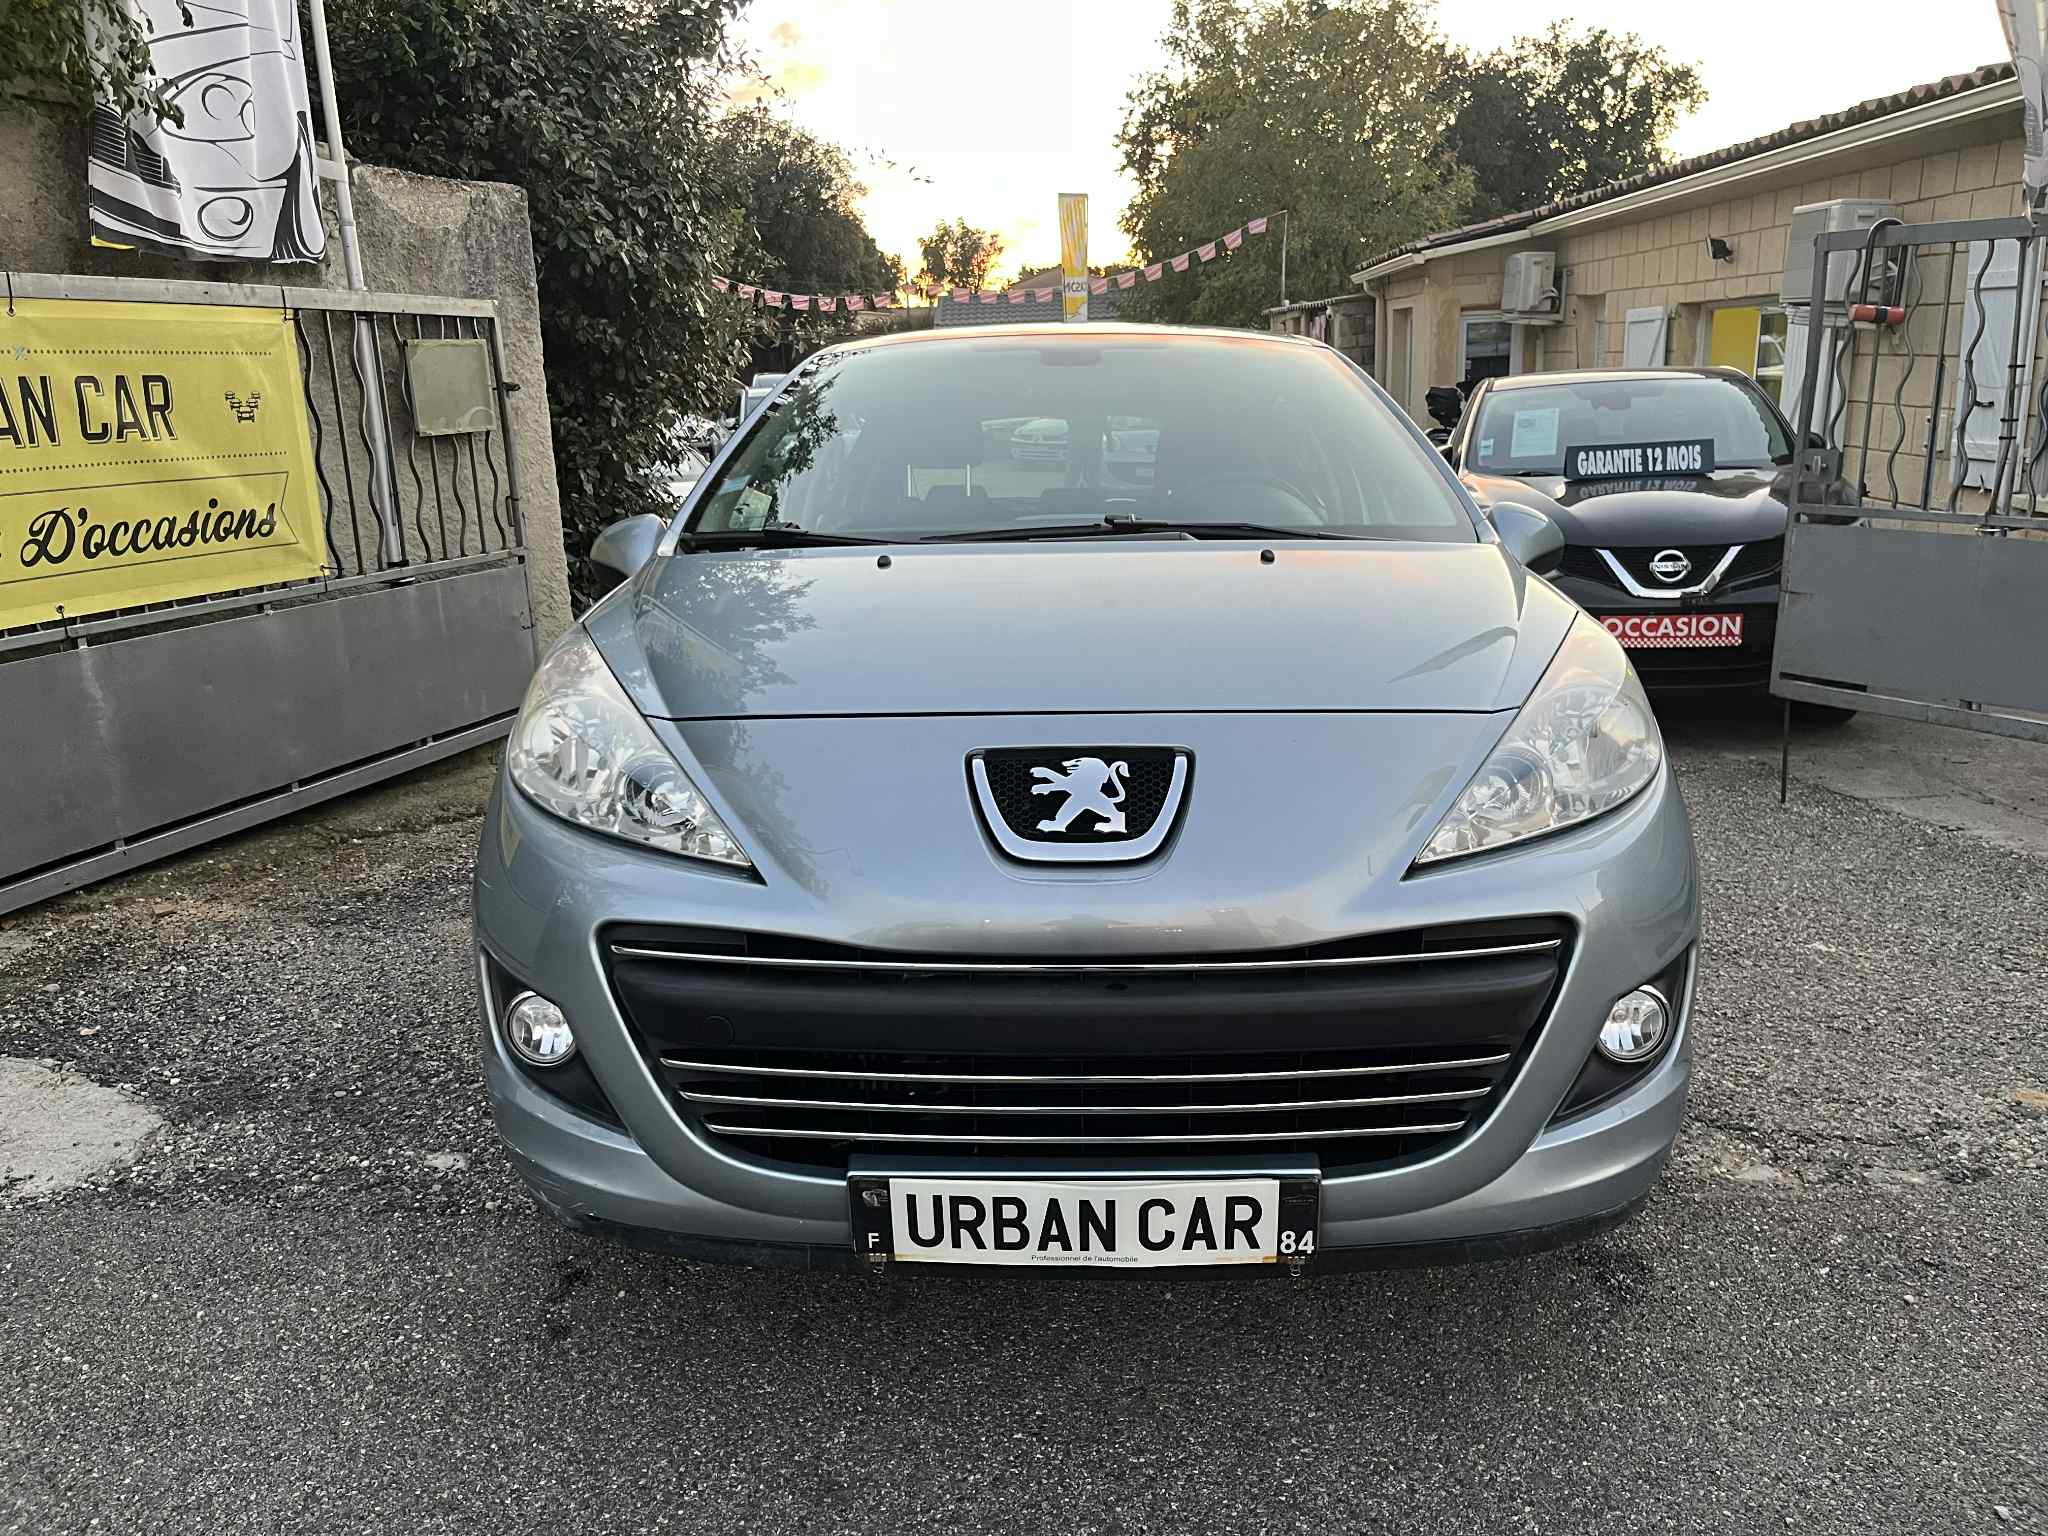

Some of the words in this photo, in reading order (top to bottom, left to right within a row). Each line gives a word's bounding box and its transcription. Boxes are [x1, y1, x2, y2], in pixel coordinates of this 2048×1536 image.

[74, 374, 177, 444] CAR
[1577, 447, 1643, 476] GARANTIE
[1647, 446, 1663, 472] 12
[1666, 444, 1702, 472] MOIS
[20, 498, 277, 568] D'occasions
[1603, 616, 1741, 637] OCCASION
[905, 1193, 1117, 1252] URBAN
[1138, 1195, 1263, 1252] CAR
[868, 1232, 880, 1249] F
[1279, 1230, 1315, 1255] 84
[1031, 1254, 1081, 1262] Professionnel
[1083, 1254, 1091, 1262] de
[1094, 1255, 1138, 1263] l'automobile
